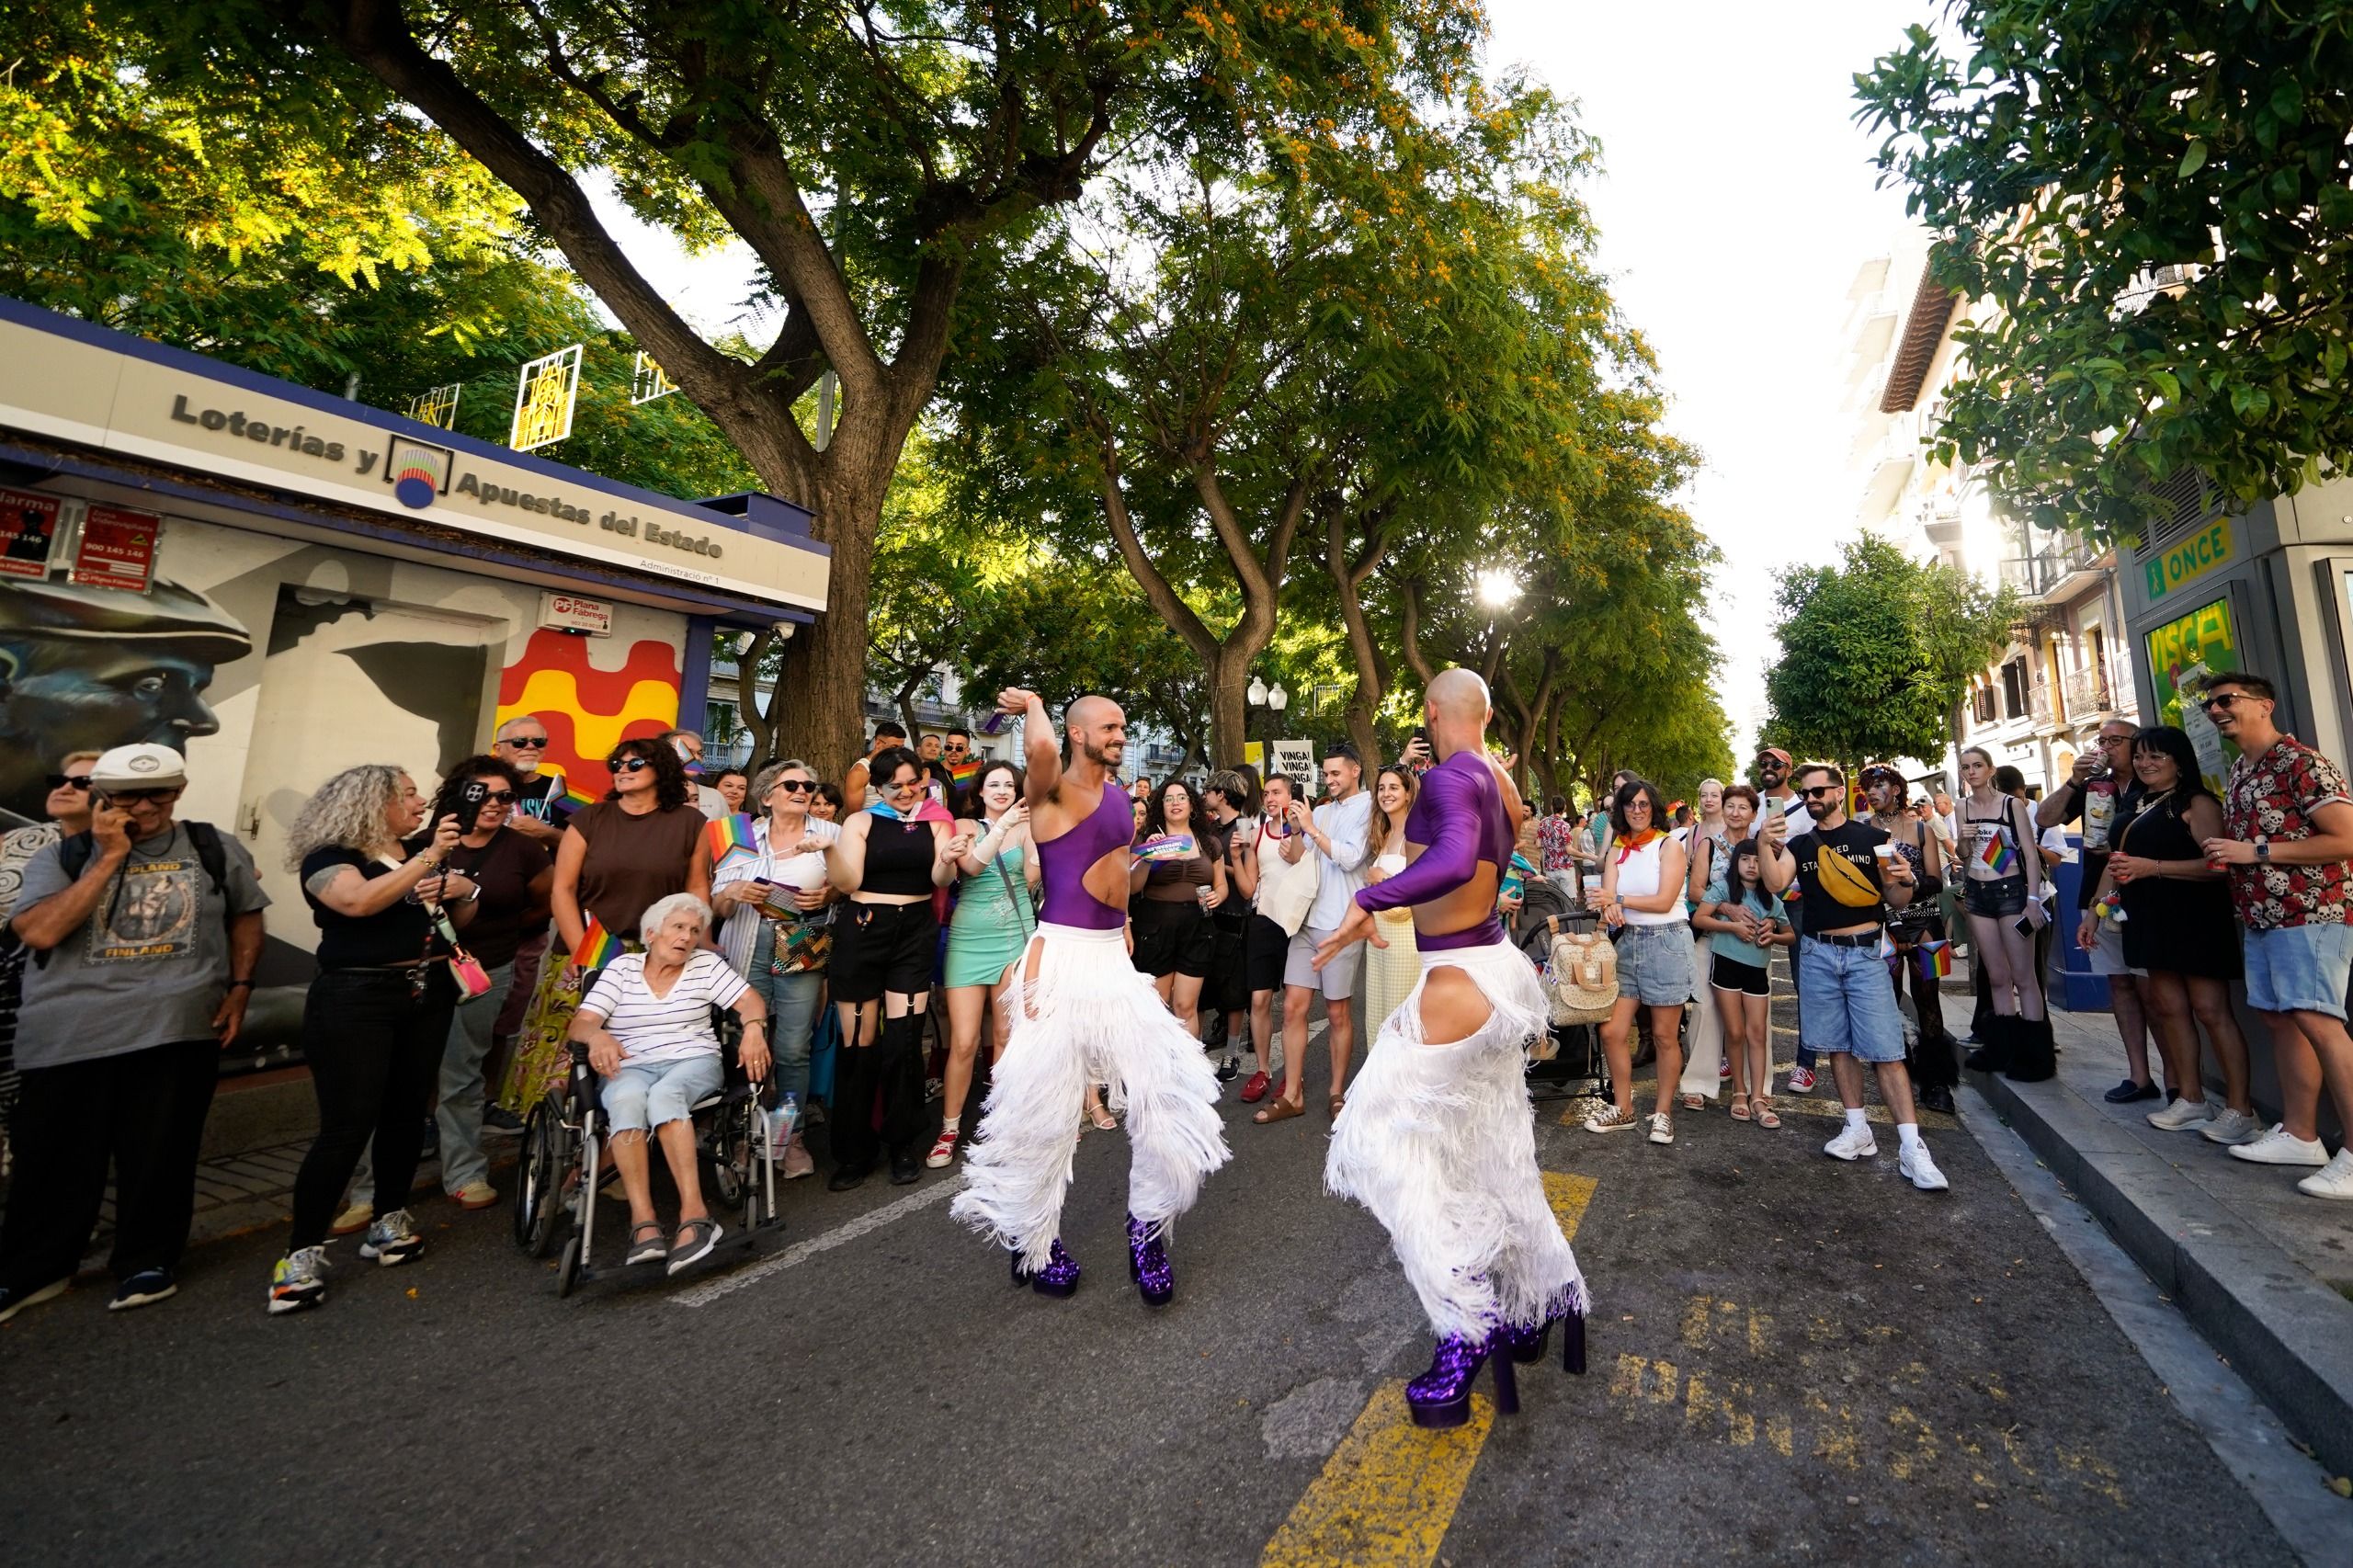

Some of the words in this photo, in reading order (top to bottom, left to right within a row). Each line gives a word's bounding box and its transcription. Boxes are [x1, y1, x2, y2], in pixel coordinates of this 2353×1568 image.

[171, 394, 345, 461] Loterías
[355, 449, 379, 474] y
[455, 472, 590, 525] Apuestas
[600, 511, 637, 538] del
[644, 522, 722, 558] Estado
[85, 542, 104, 551] 900
[127, 550, 144, 558] 146
[2170, 526, 2225, 581] ONCE
[640, 560, 700, 581] Administració
[554, 599, 572, 612] PF
[574, 600, 599, 610] Plana
[1279, 751, 1310, 761] VINGA!
[1281, 762, 1312, 772] VINGA!
[1289, 772, 1313, 783] NGA!
[1847, 855, 1870, 864] MIND
[129, 863, 182, 874] PLAND
[1802, 861, 1819, 872] STA
[105, 944, 174, 957] FINLAND
